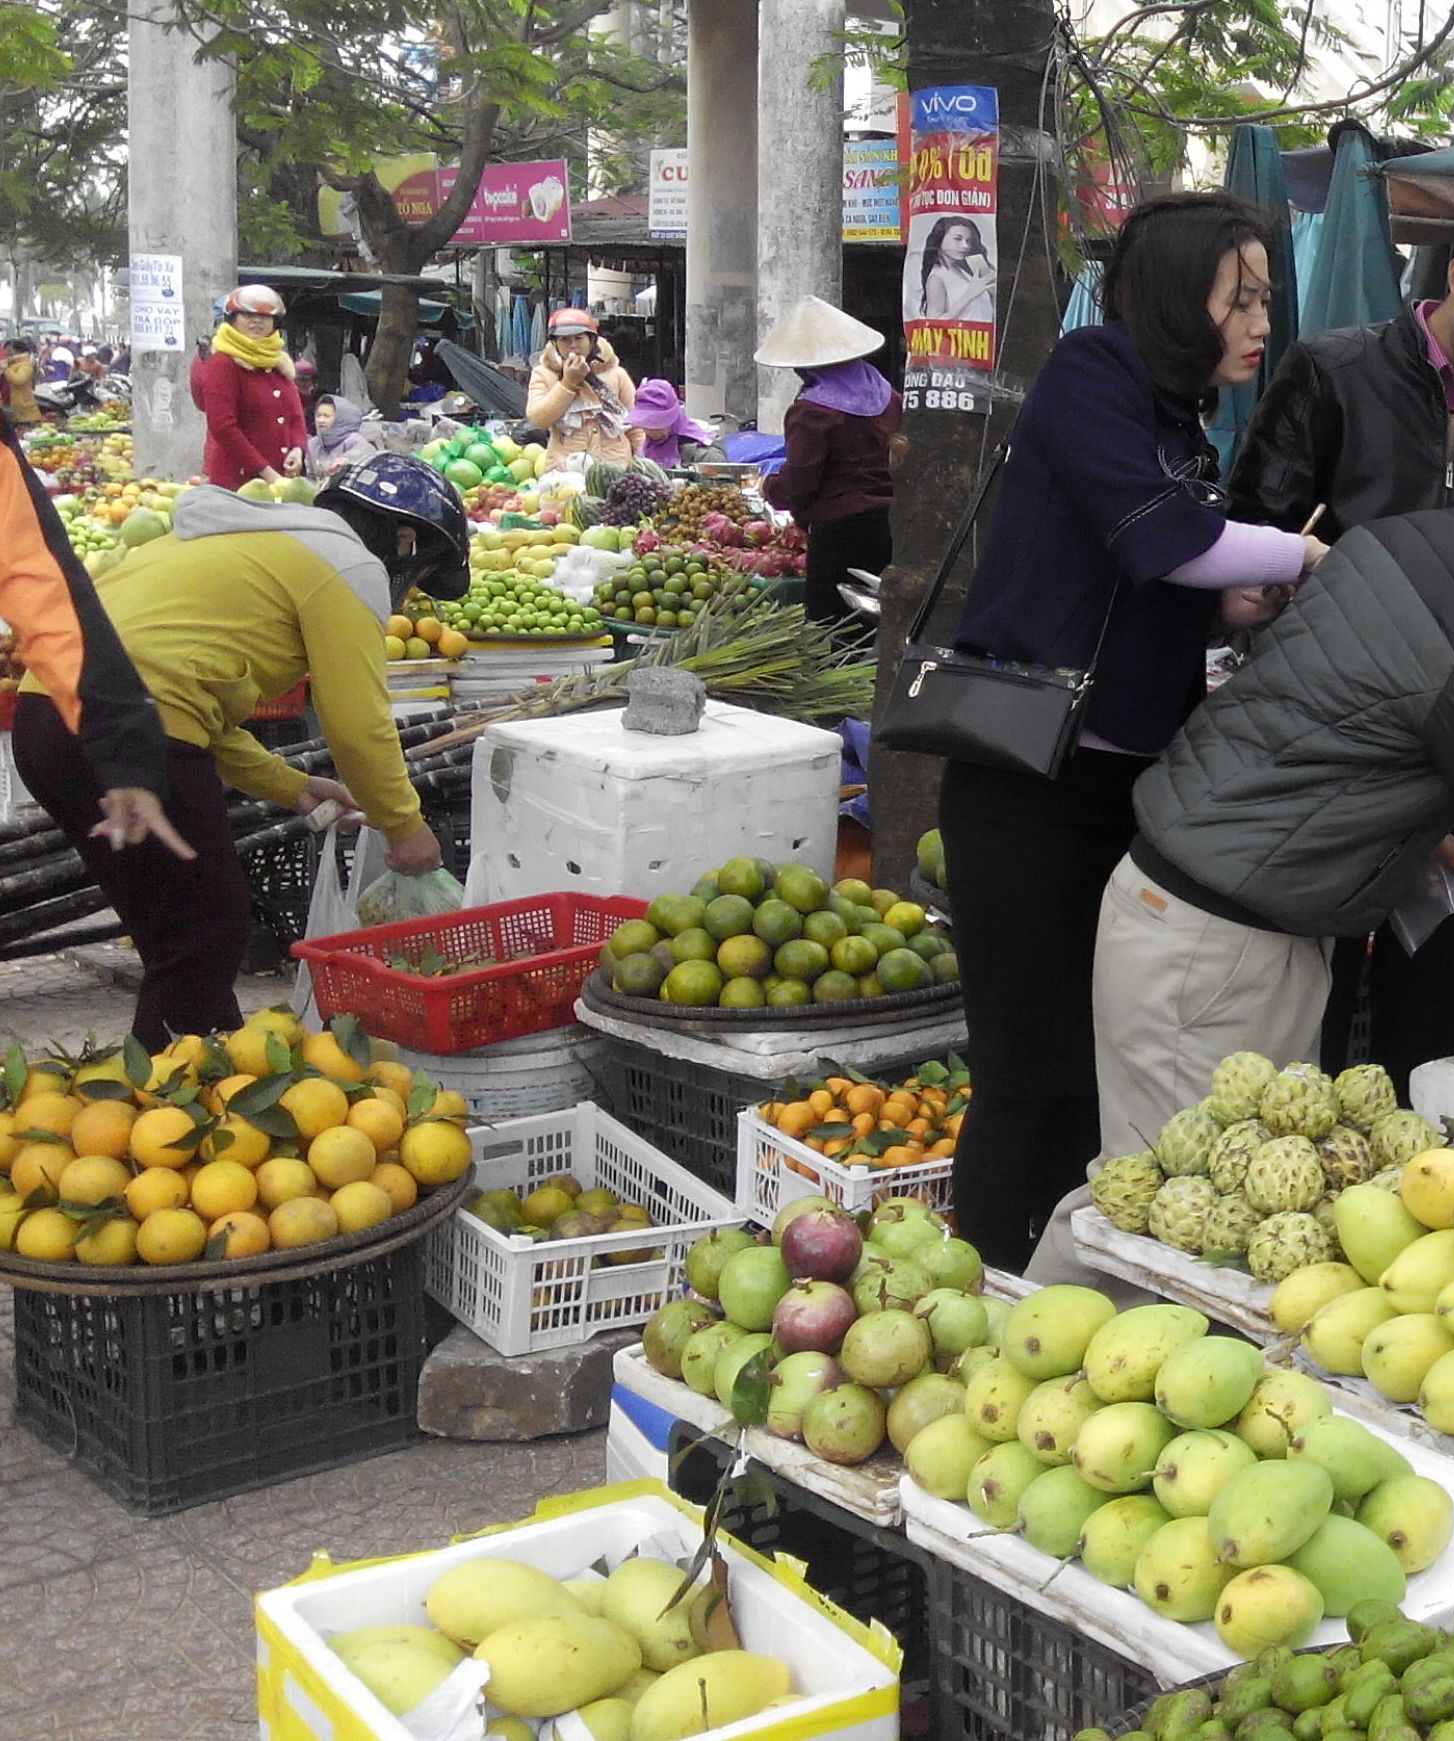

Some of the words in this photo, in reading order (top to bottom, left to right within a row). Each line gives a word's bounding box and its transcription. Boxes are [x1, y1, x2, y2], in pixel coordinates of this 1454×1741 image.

[156, 306, 179, 316] VAY
[947, 322, 990, 360] TÍNH
[925, 389, 975, 411] 886
